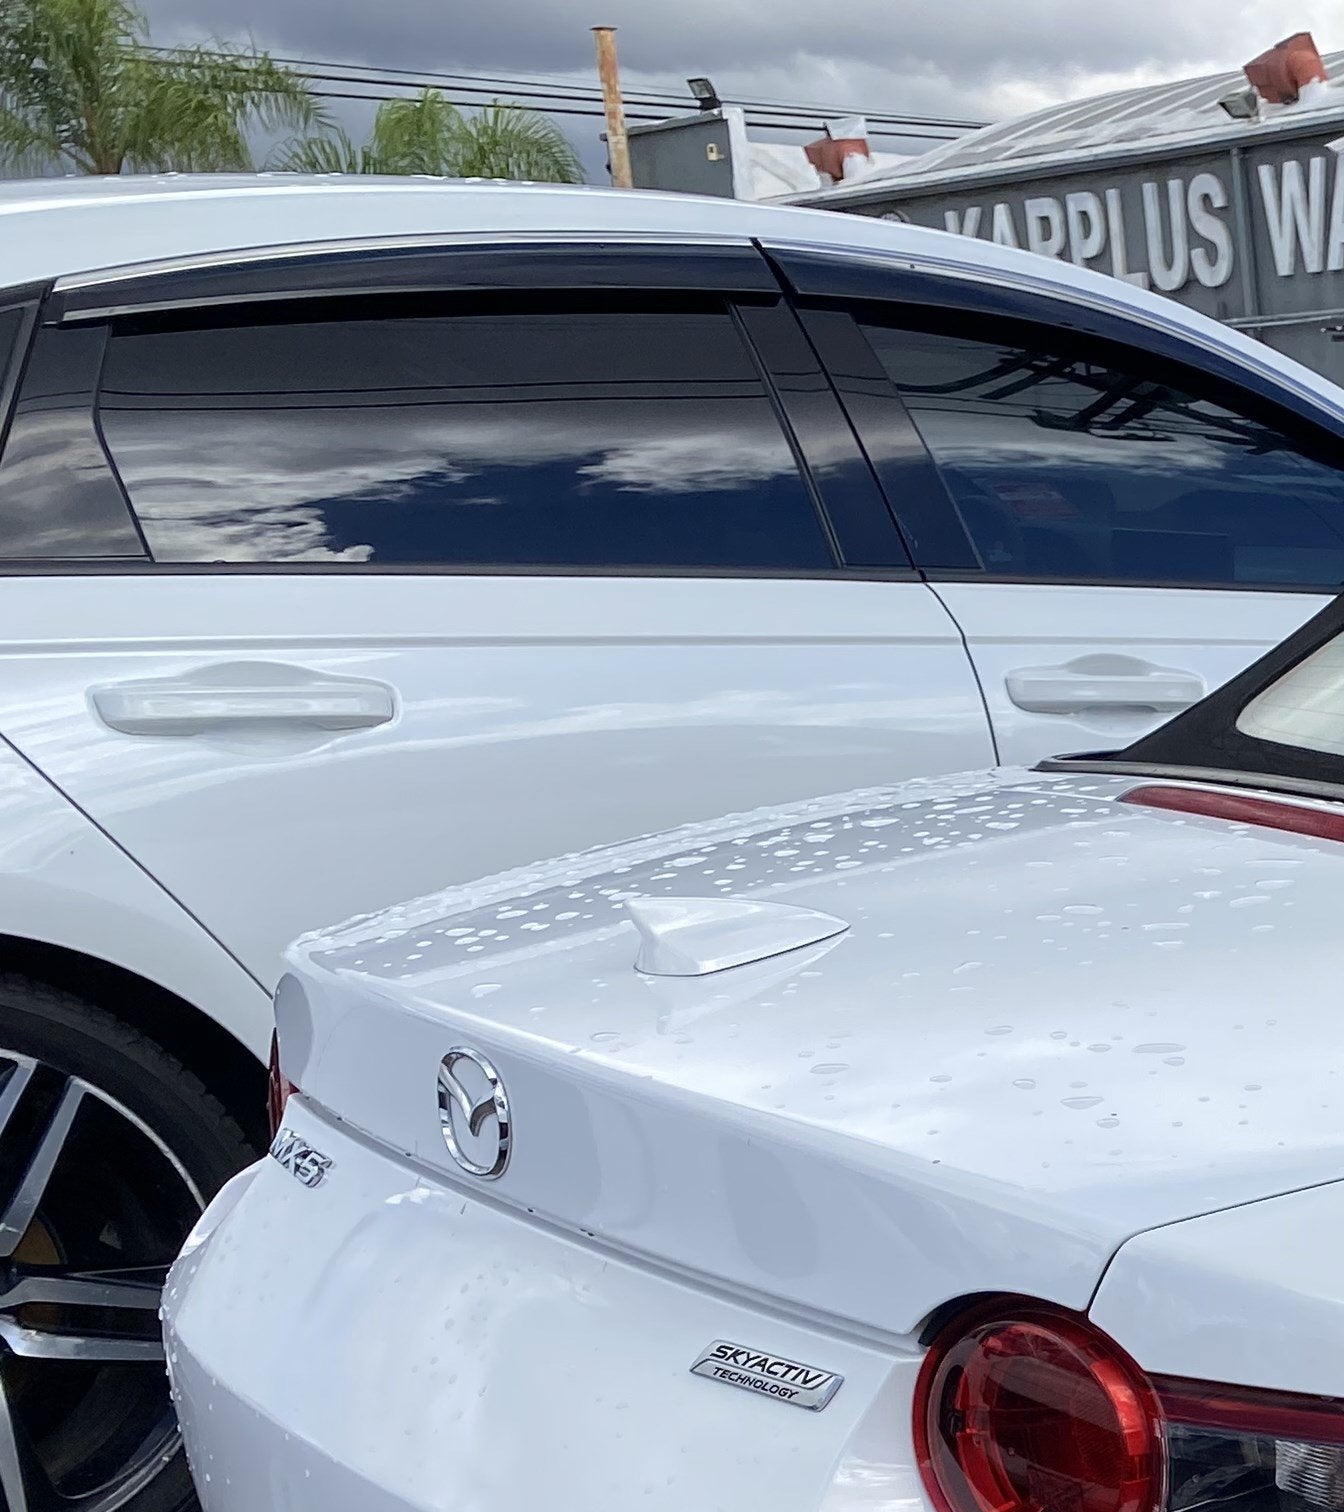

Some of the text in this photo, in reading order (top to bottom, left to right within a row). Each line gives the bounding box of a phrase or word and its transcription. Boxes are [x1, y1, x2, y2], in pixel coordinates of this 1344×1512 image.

[943, 171, 1235, 291] RPLUS
[709, 1344, 823, 1386] SKYACTIV
[712, 1366, 800, 1400] TECHNOLOGY
